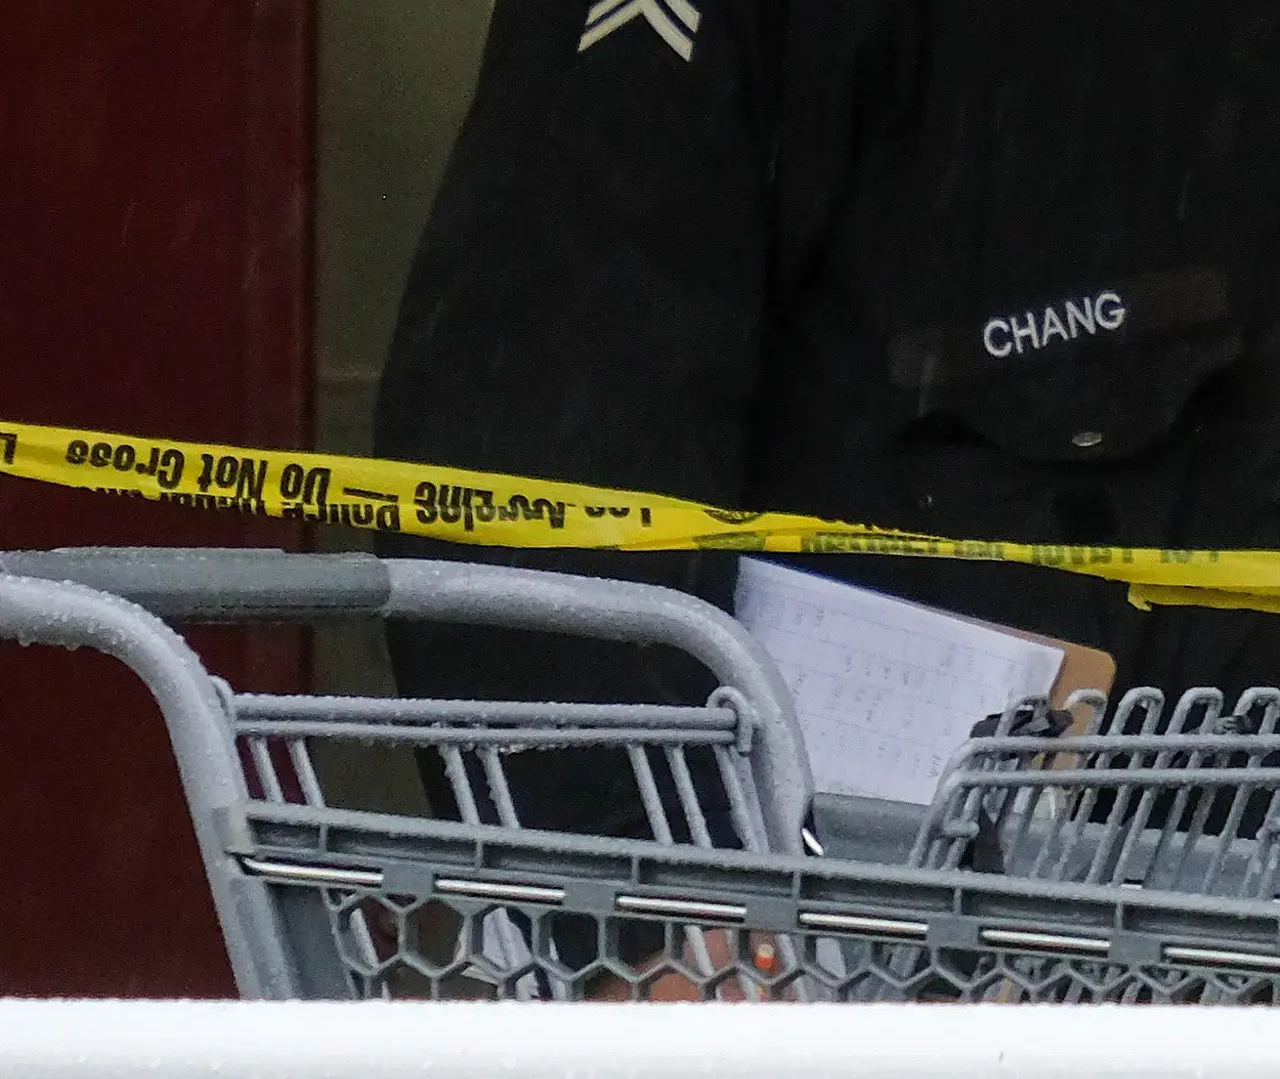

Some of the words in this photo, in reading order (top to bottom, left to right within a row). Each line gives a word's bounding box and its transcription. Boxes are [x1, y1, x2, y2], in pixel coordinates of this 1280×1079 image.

[983, 291, 1128, 358] CHANG
[66, 440, 185, 489] Cross
[197, 453, 267, 501] Not
[280, 464, 331, 506] Do
